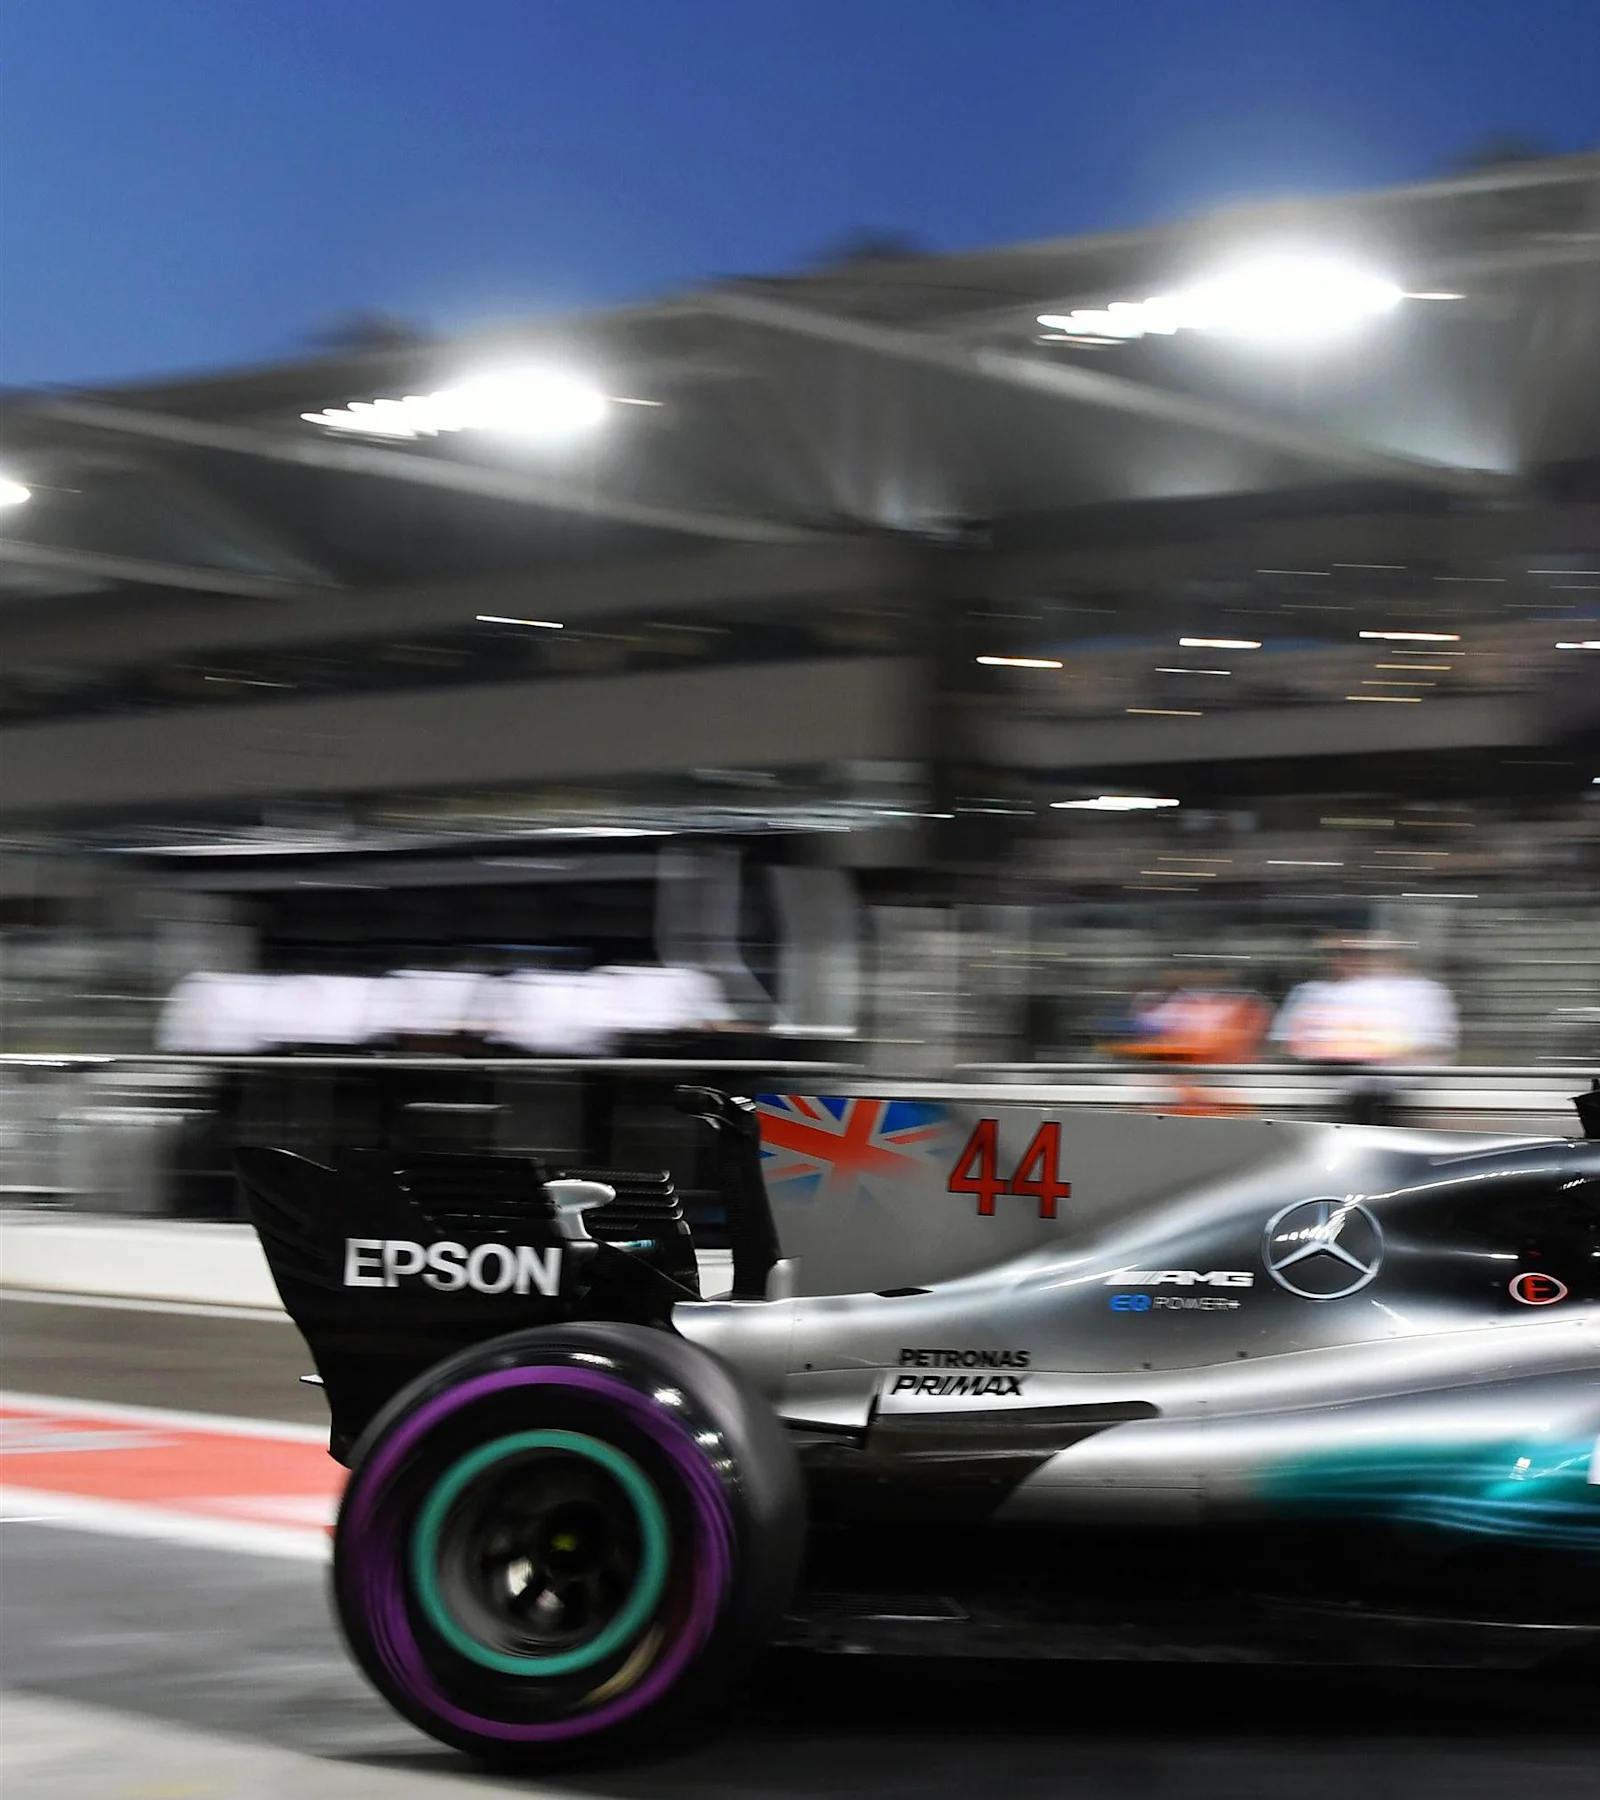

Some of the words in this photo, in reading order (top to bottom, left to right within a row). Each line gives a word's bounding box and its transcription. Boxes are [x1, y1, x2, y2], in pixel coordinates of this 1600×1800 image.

[947, 1118, 1071, 1218] 44
[343, 1237, 563, 1296] EPSON
[1147, 1270, 1255, 1287] AMG
[1109, 1294, 1149, 1311] EQ
[900, 1348, 1031, 1368] PETRONAS
[890, 1374, 1023, 1396] PRIMAX
